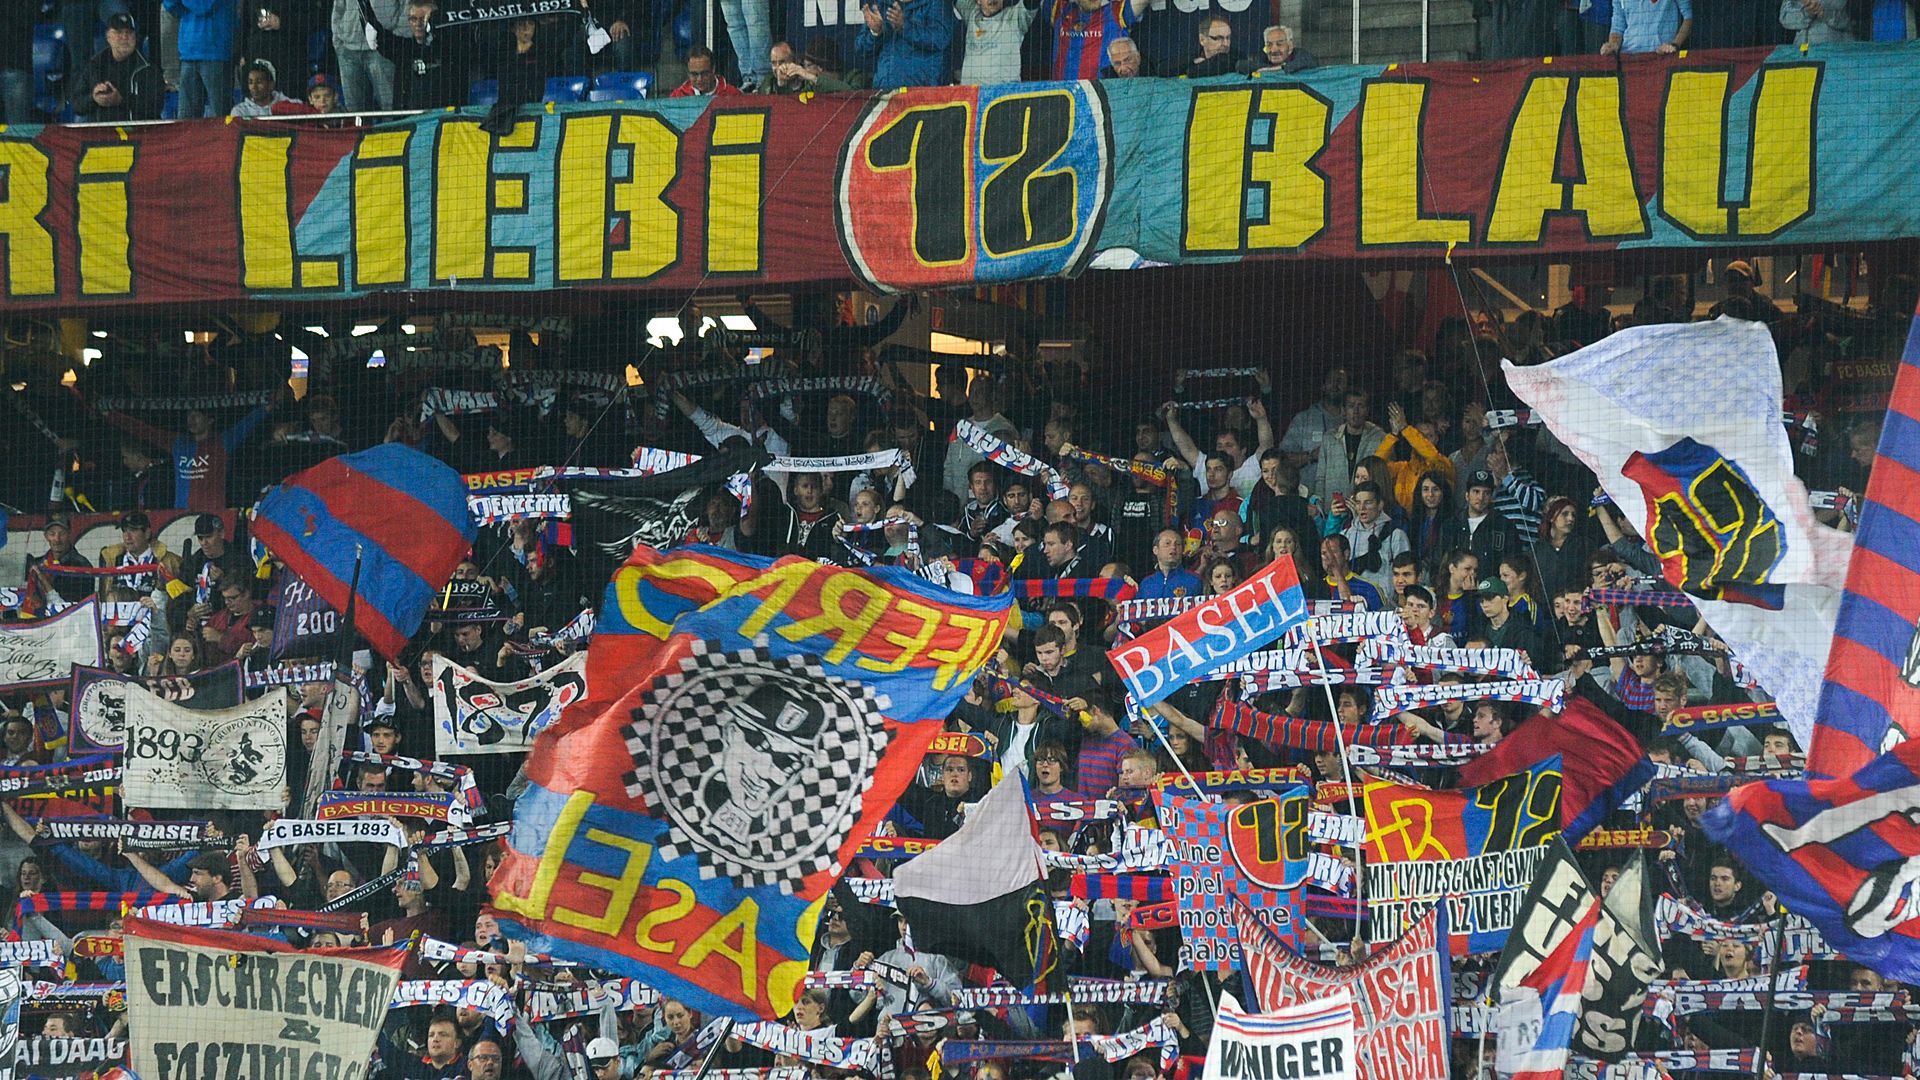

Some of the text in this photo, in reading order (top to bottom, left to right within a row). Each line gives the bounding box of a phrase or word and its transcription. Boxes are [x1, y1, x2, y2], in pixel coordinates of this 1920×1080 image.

[446, 0, 572, 22] FC BASEL 1893
[1181, 62, 1825, 258] BLAU
[179, 454, 209, 467] PAX
[792, 455, 842, 467] BASEL
[1114, 571, 1306, 700] BASEL
[215, 721, 244, 744] GRUPPO
[246, 720, 275, 736] ATTIVO
[124, 726, 204, 769] 1893
[83, 767, 123, 783] 2007
[1157, 766, 1305, 791] FC BASEL
[51, 822, 134, 838] INFERNO
[138, 824, 202, 842] BASEL
[267, 822, 391, 841] FC BASEL 1893
[1580, 829, 1651, 847] BASEL
[856, 838, 894, 854] FC
[1367, 863, 1396, 901] MIT
[1136, 906, 1174, 926] FC
[1369, 903, 1404, 942] MIT
[88, 938, 114, 954] FC
[1675, 992, 1895, 1016] BASEL
[279, 1017, 321, 1045] &
[50, 1037, 126, 1065] DAAG
